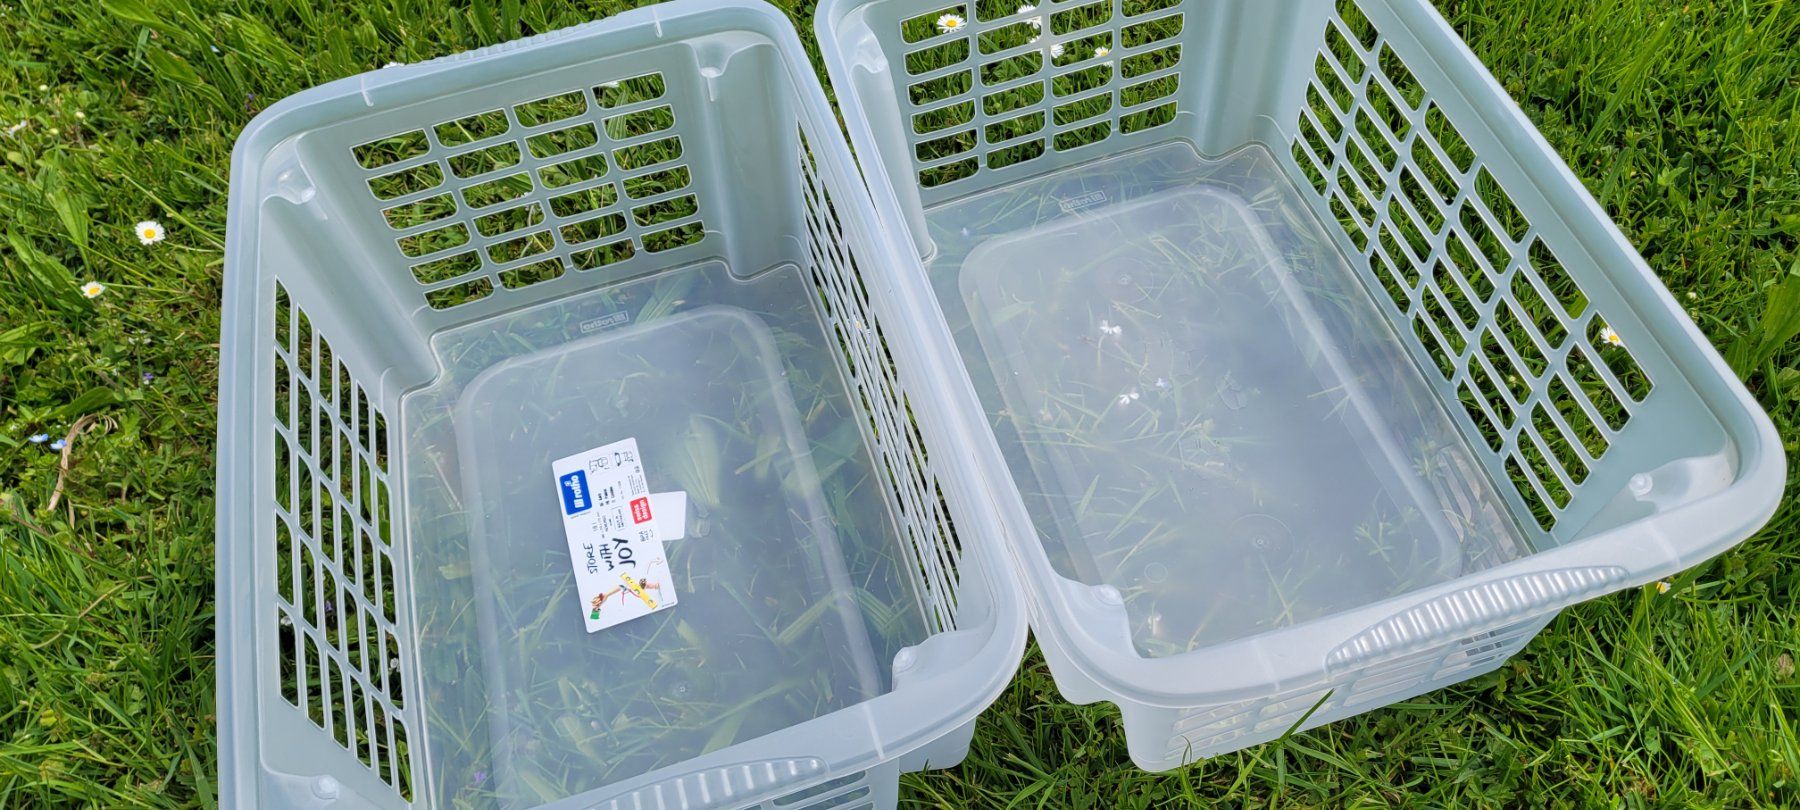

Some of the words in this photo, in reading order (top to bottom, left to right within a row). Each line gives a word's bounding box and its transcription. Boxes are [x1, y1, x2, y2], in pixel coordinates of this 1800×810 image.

[573, 475, 583, 499] rotho
[633, 504, 641, 521] swiss
[639, 500, 648, 520] design
[583, 543, 598, 574] STORE
[600, 543, 614, 572] WITH
[612, 537, 636, 568] JOY
